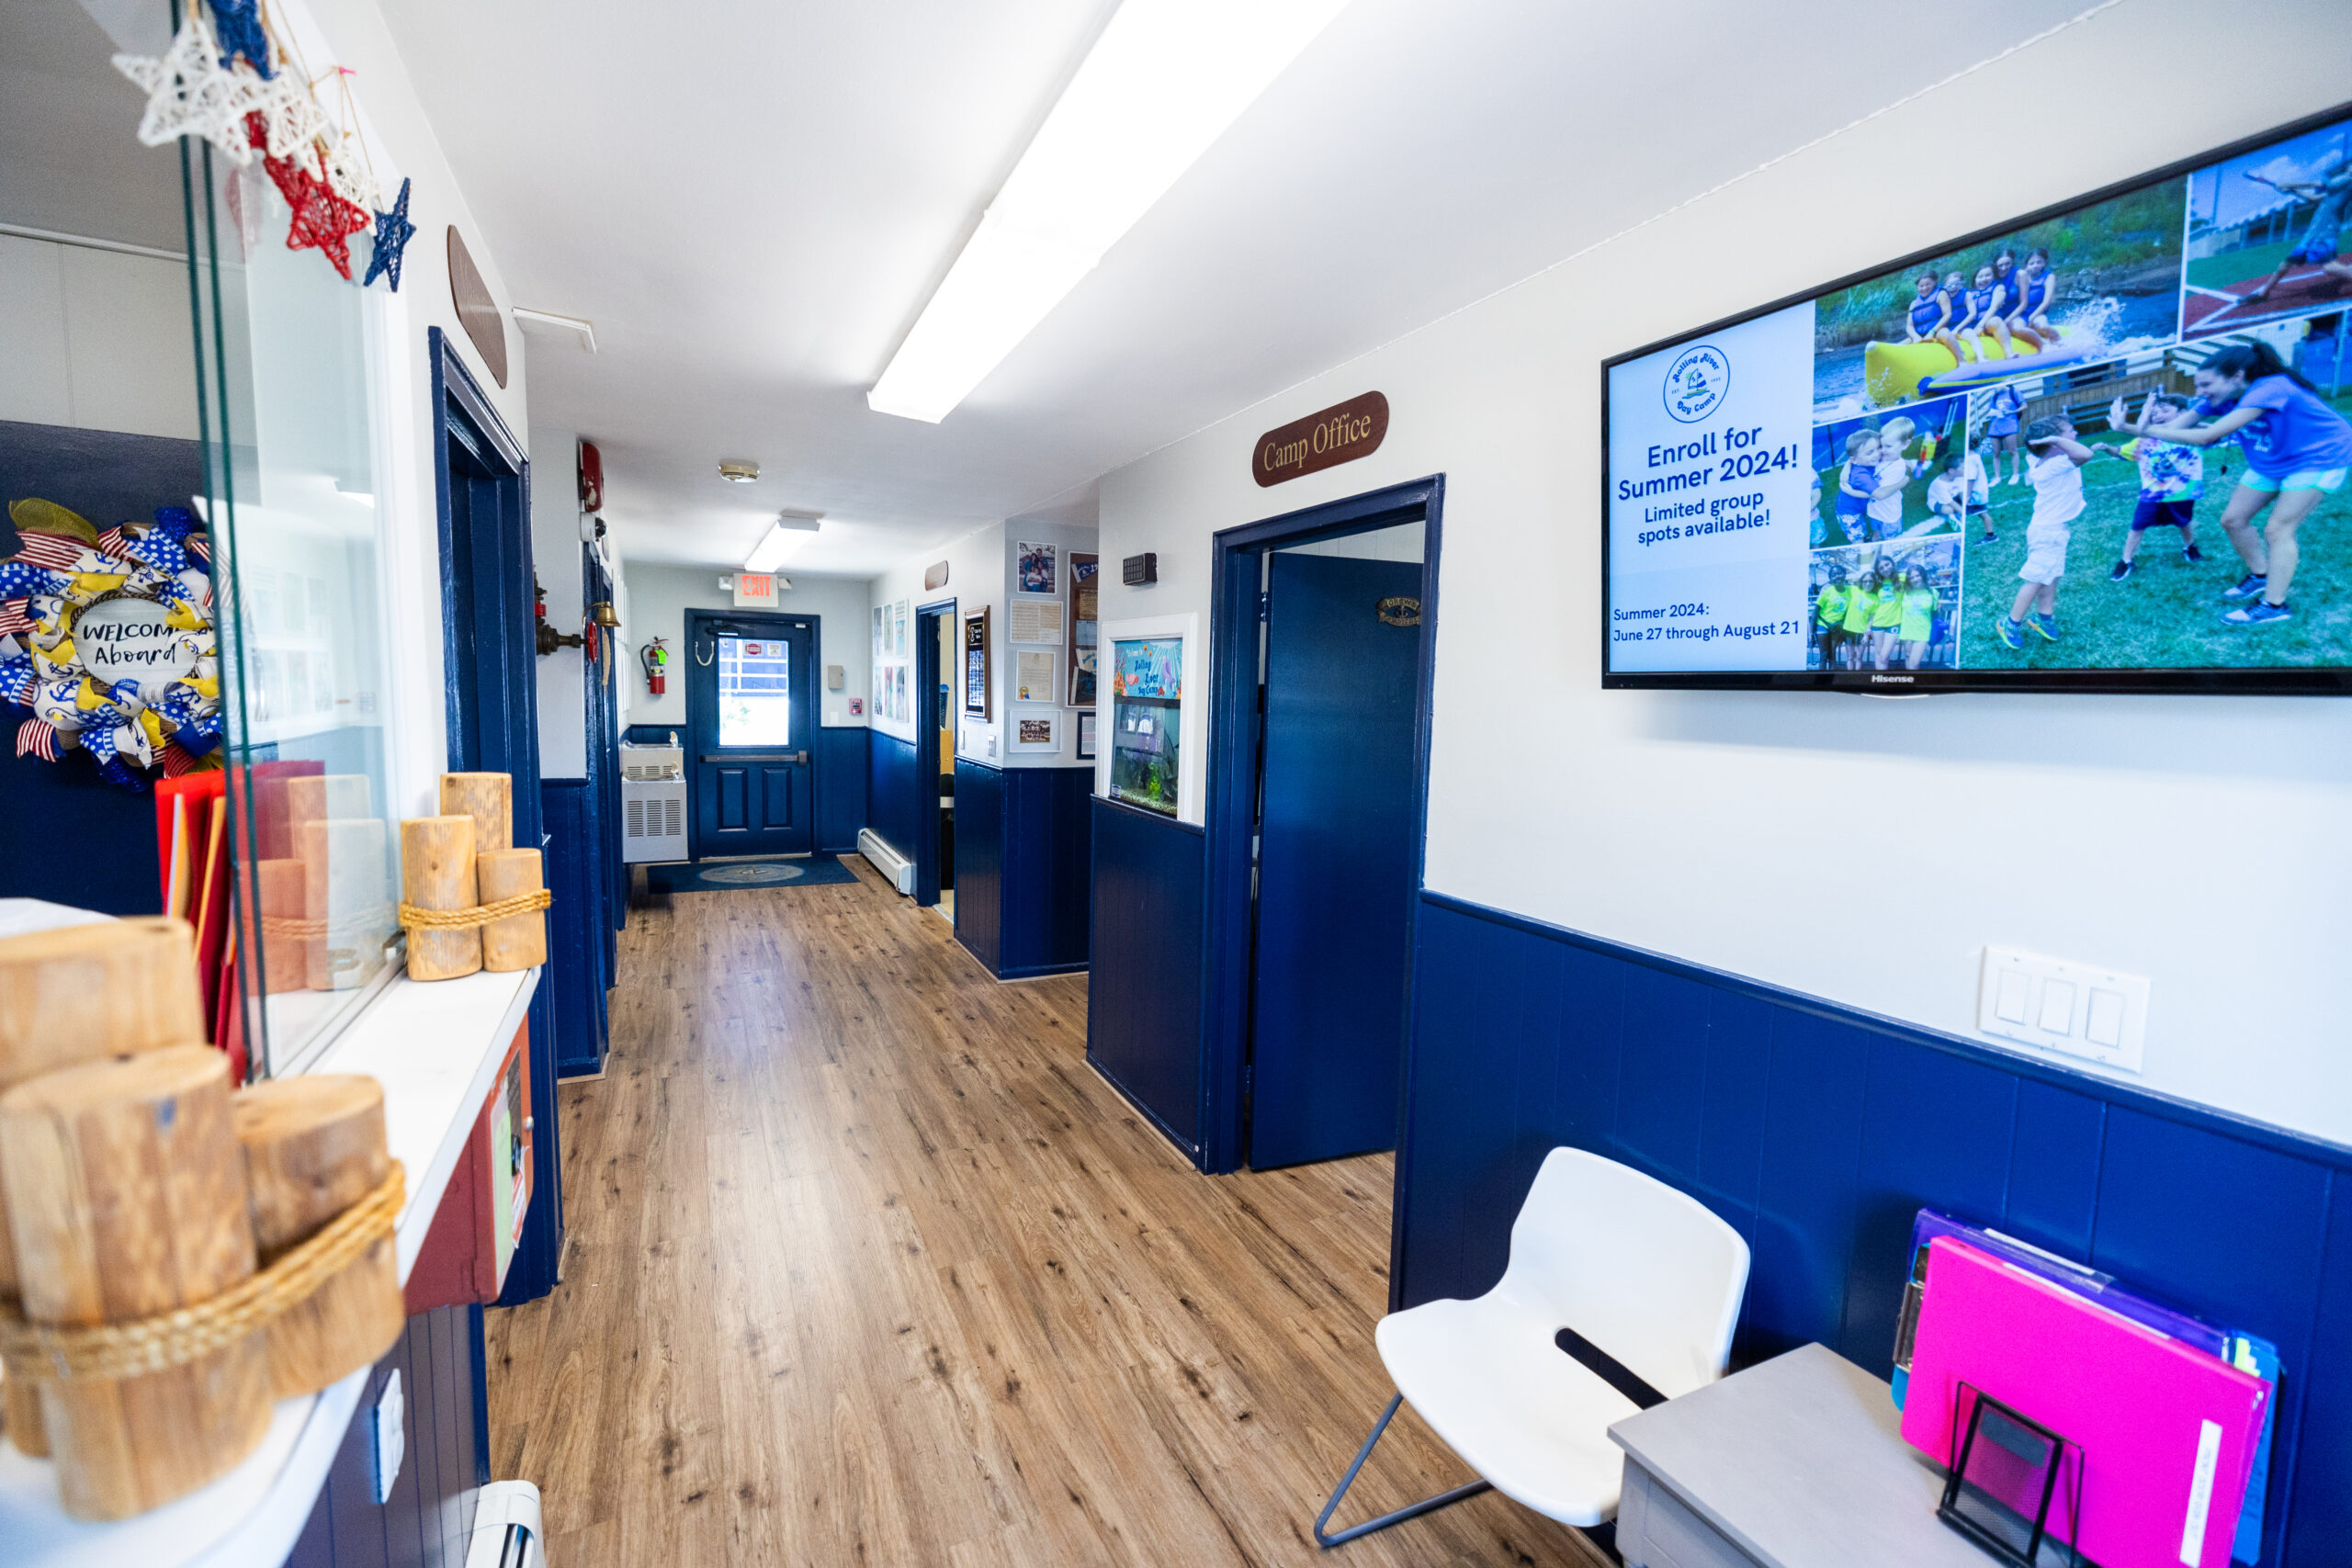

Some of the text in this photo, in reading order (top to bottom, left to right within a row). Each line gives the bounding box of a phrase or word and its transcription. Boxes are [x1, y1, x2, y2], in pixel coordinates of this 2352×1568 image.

[1672, 353, 1719, 383] Rolling River
[1677, 392, 1715, 415] Day Camp
[1263, 412, 1371, 471] Camp Office
[1648, 426, 1762, 468] Enroll for
[1618, 444, 1798, 501] Summer 2024!
[1645, 491, 1764, 524] Limited group
[1638, 509, 1770, 547] spots available!
[741, 574, 772, 597] EXIT
[1613, 603, 1710, 621] Summer 2024:
[83, 623, 180, 642] WELCOM
[1613, 621, 1799, 642] June 27 through August 21
[95, 643, 176, 666] Aboard
[1871, 674, 1915, 683] Hisense
